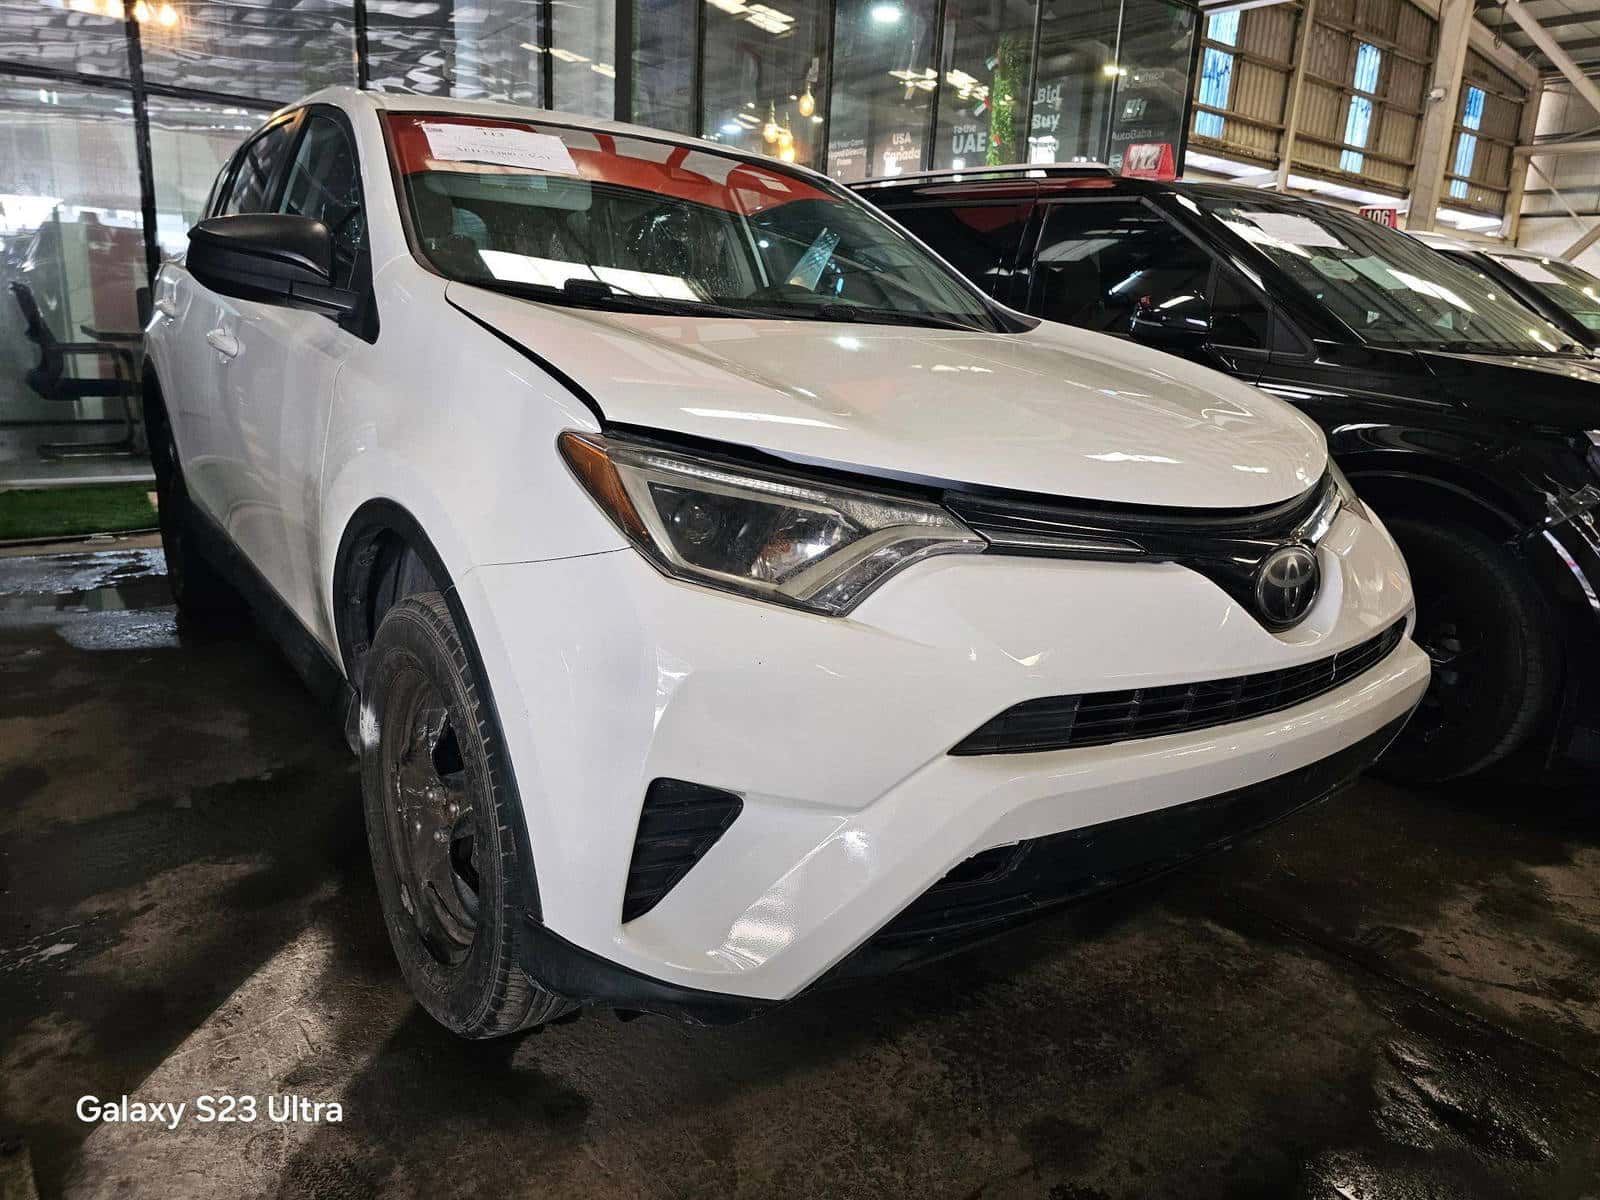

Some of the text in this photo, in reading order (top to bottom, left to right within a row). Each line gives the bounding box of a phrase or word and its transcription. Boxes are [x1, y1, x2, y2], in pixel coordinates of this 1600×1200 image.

[1031, 113, 1060, 132] Buy
[892, 131, 912, 145] USA
[952, 132, 987, 154] UAE
[1366, 210, 1389, 225] 106
